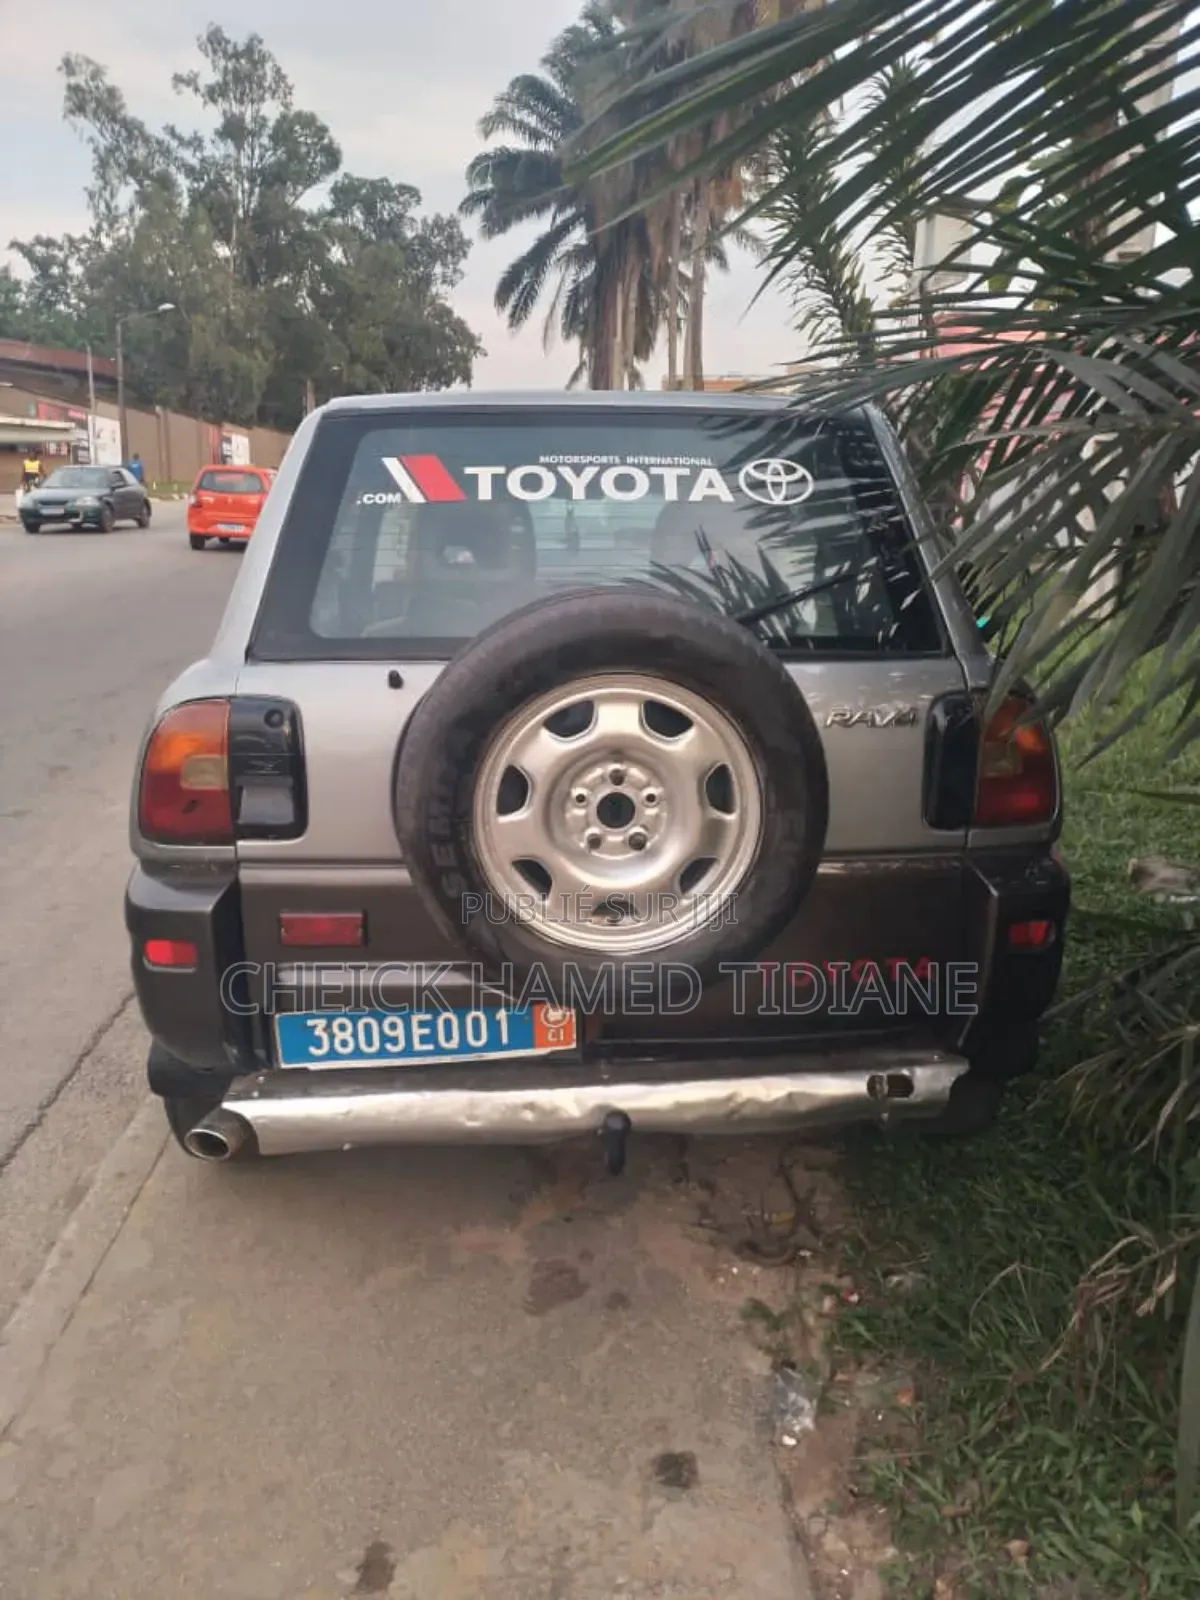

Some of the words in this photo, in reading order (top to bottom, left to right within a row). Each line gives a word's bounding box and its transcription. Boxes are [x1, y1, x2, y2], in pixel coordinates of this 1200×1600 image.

[538, 455, 620, 465] MOTORSPORTS
[626, 456, 713, 467] INTERNATIONAL
[463, 465, 735, 503] TOYOTA
[356, 492, 402, 505] .COM
